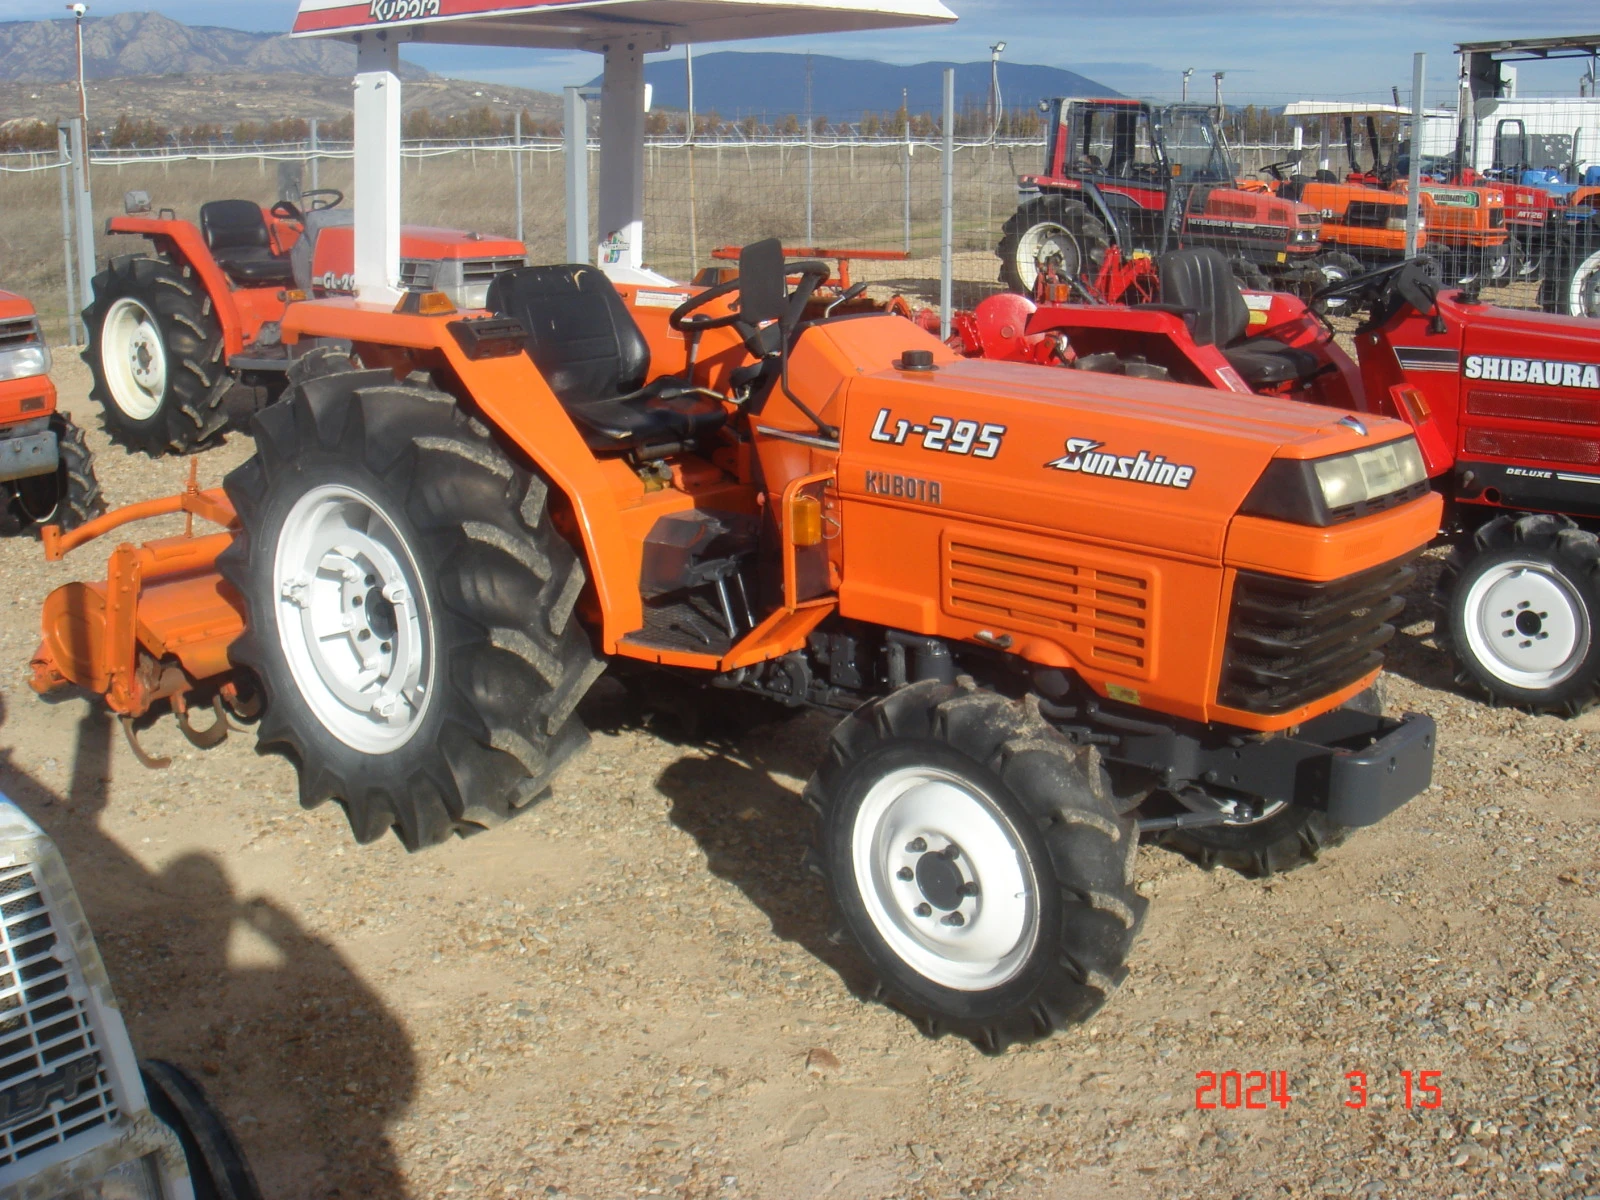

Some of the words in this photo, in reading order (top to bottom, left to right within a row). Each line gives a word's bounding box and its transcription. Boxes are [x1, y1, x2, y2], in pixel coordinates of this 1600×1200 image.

[371, 0, 440, 21] Kubota
[1187, 217, 1232, 229] MITSUBISHI
[1465, 356, 1600, 388] SHIBAURA
[1043, 437, 1196, 490] Sunshine
[1505, 466, 1553, 479] DELUXE
[865, 470, 942, 504] KUBOTA
